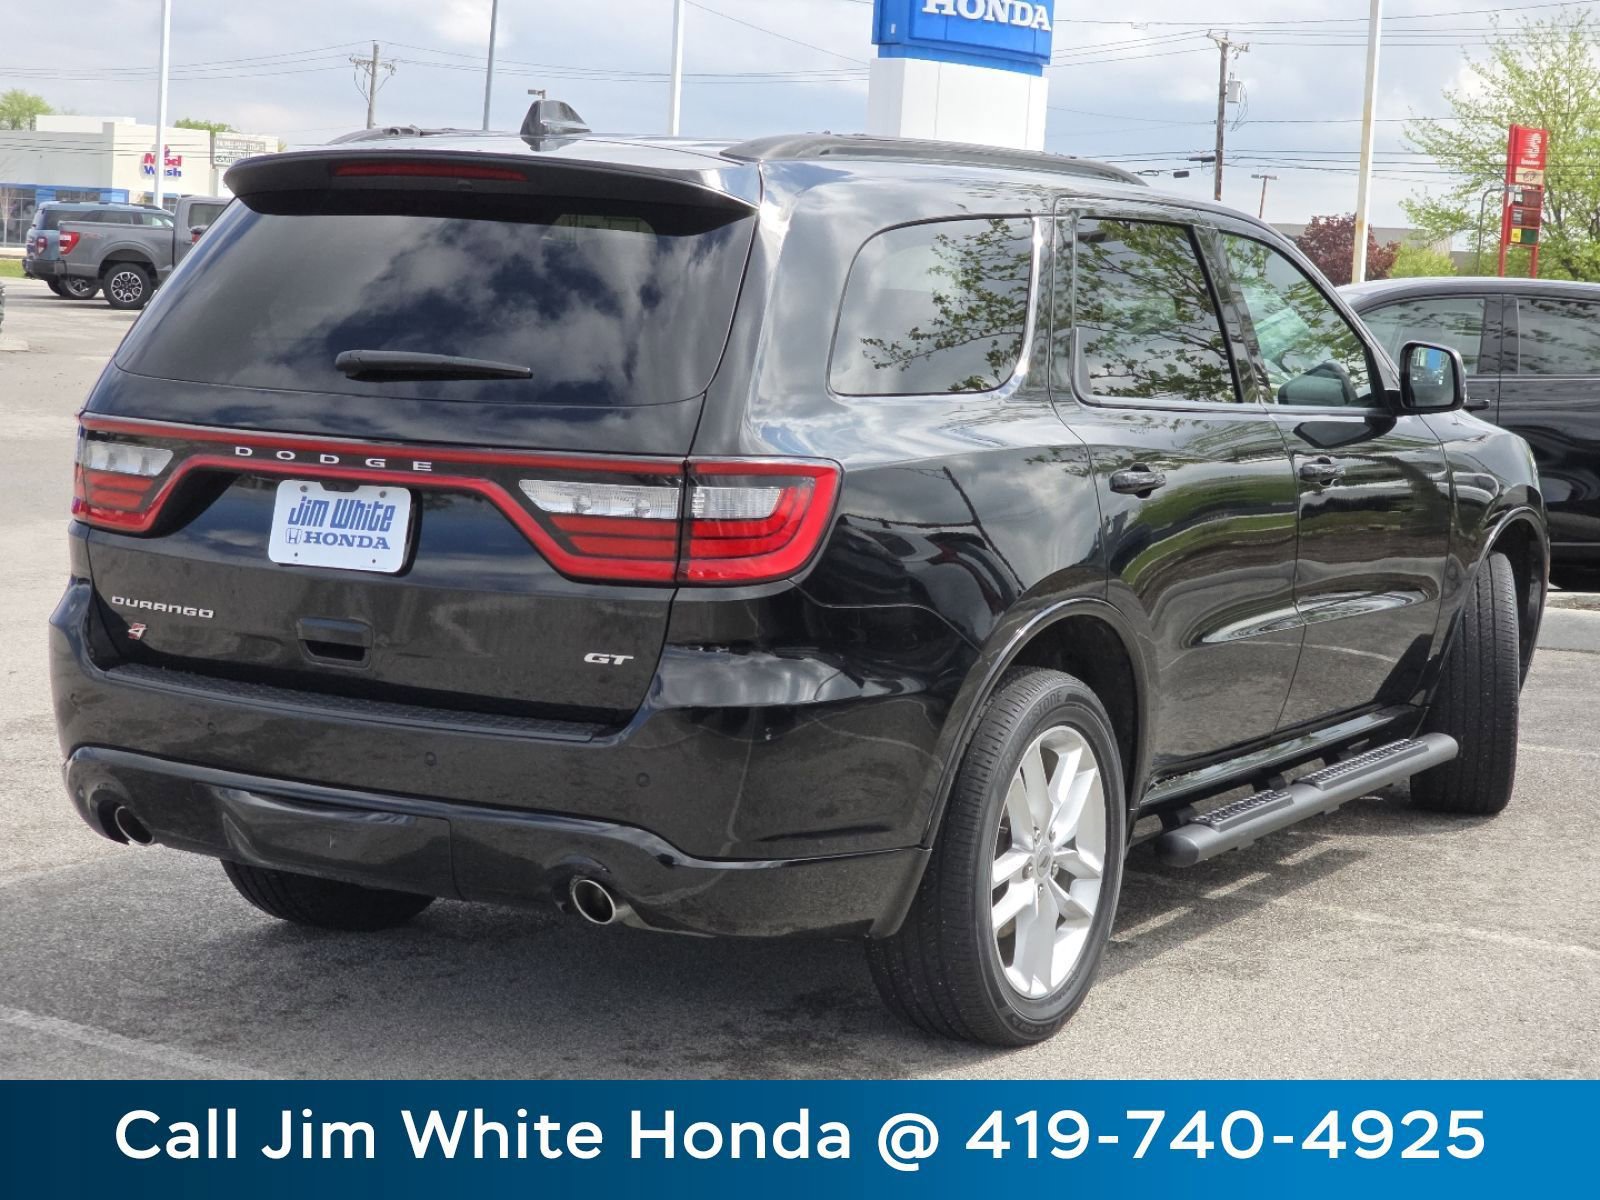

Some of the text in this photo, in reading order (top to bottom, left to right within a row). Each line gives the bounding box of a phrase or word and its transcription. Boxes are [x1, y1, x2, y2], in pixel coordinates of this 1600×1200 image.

[922, 0, 1052, 31] HONDA
[144, 165, 182, 178] Wsh
[235, 446, 433, 471] DODGE
[288, 496, 396, 532] Jim White
[303, 531, 391, 550] HONDA
[112, 596, 214, 618] DURANGO
[584, 652, 634, 665] GT
